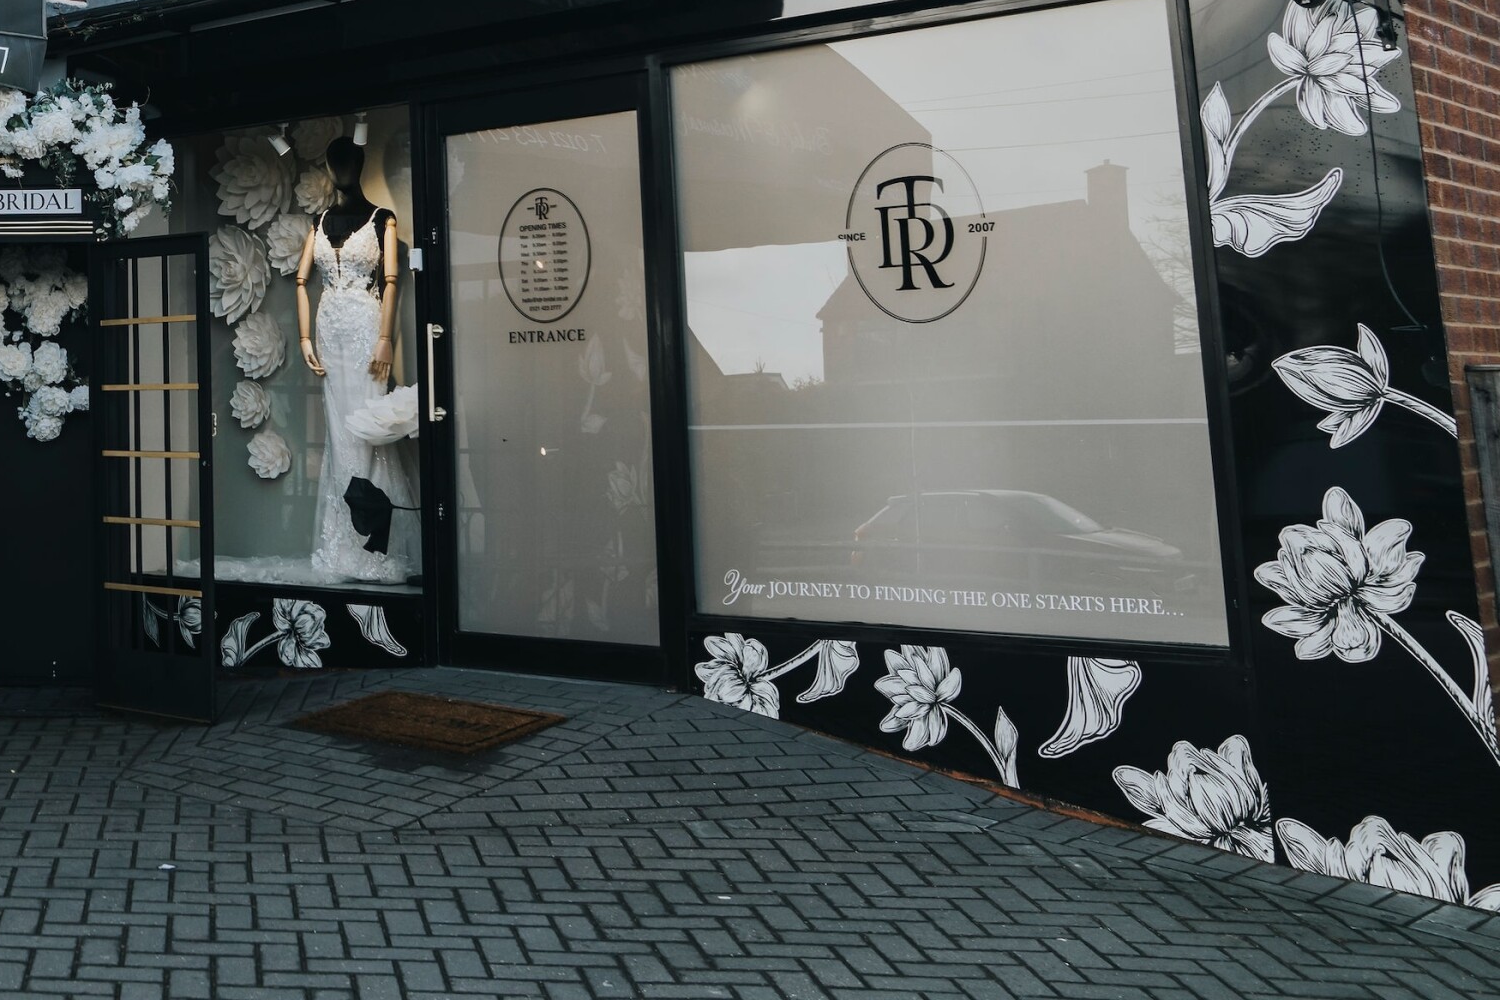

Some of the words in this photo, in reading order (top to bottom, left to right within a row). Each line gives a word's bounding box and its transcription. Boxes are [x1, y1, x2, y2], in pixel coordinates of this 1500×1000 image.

[519, 223, 547, 232] OPENING
[548, 221, 567, 230] TIMES
[968, 221, 996, 234] 2007
[509, 329, 586, 344] ENTRANCE
[722, 568, 766, 606] Your
[766, 580, 843, 600] JOURNEY
[846, 584, 871, 600] TO
[874, 585, 947, 605] FINDING
[950, 590, 988, 606] THE
[991, 592, 1032, 609] ONE
[1035, 594, 1106, 613] STARTS
